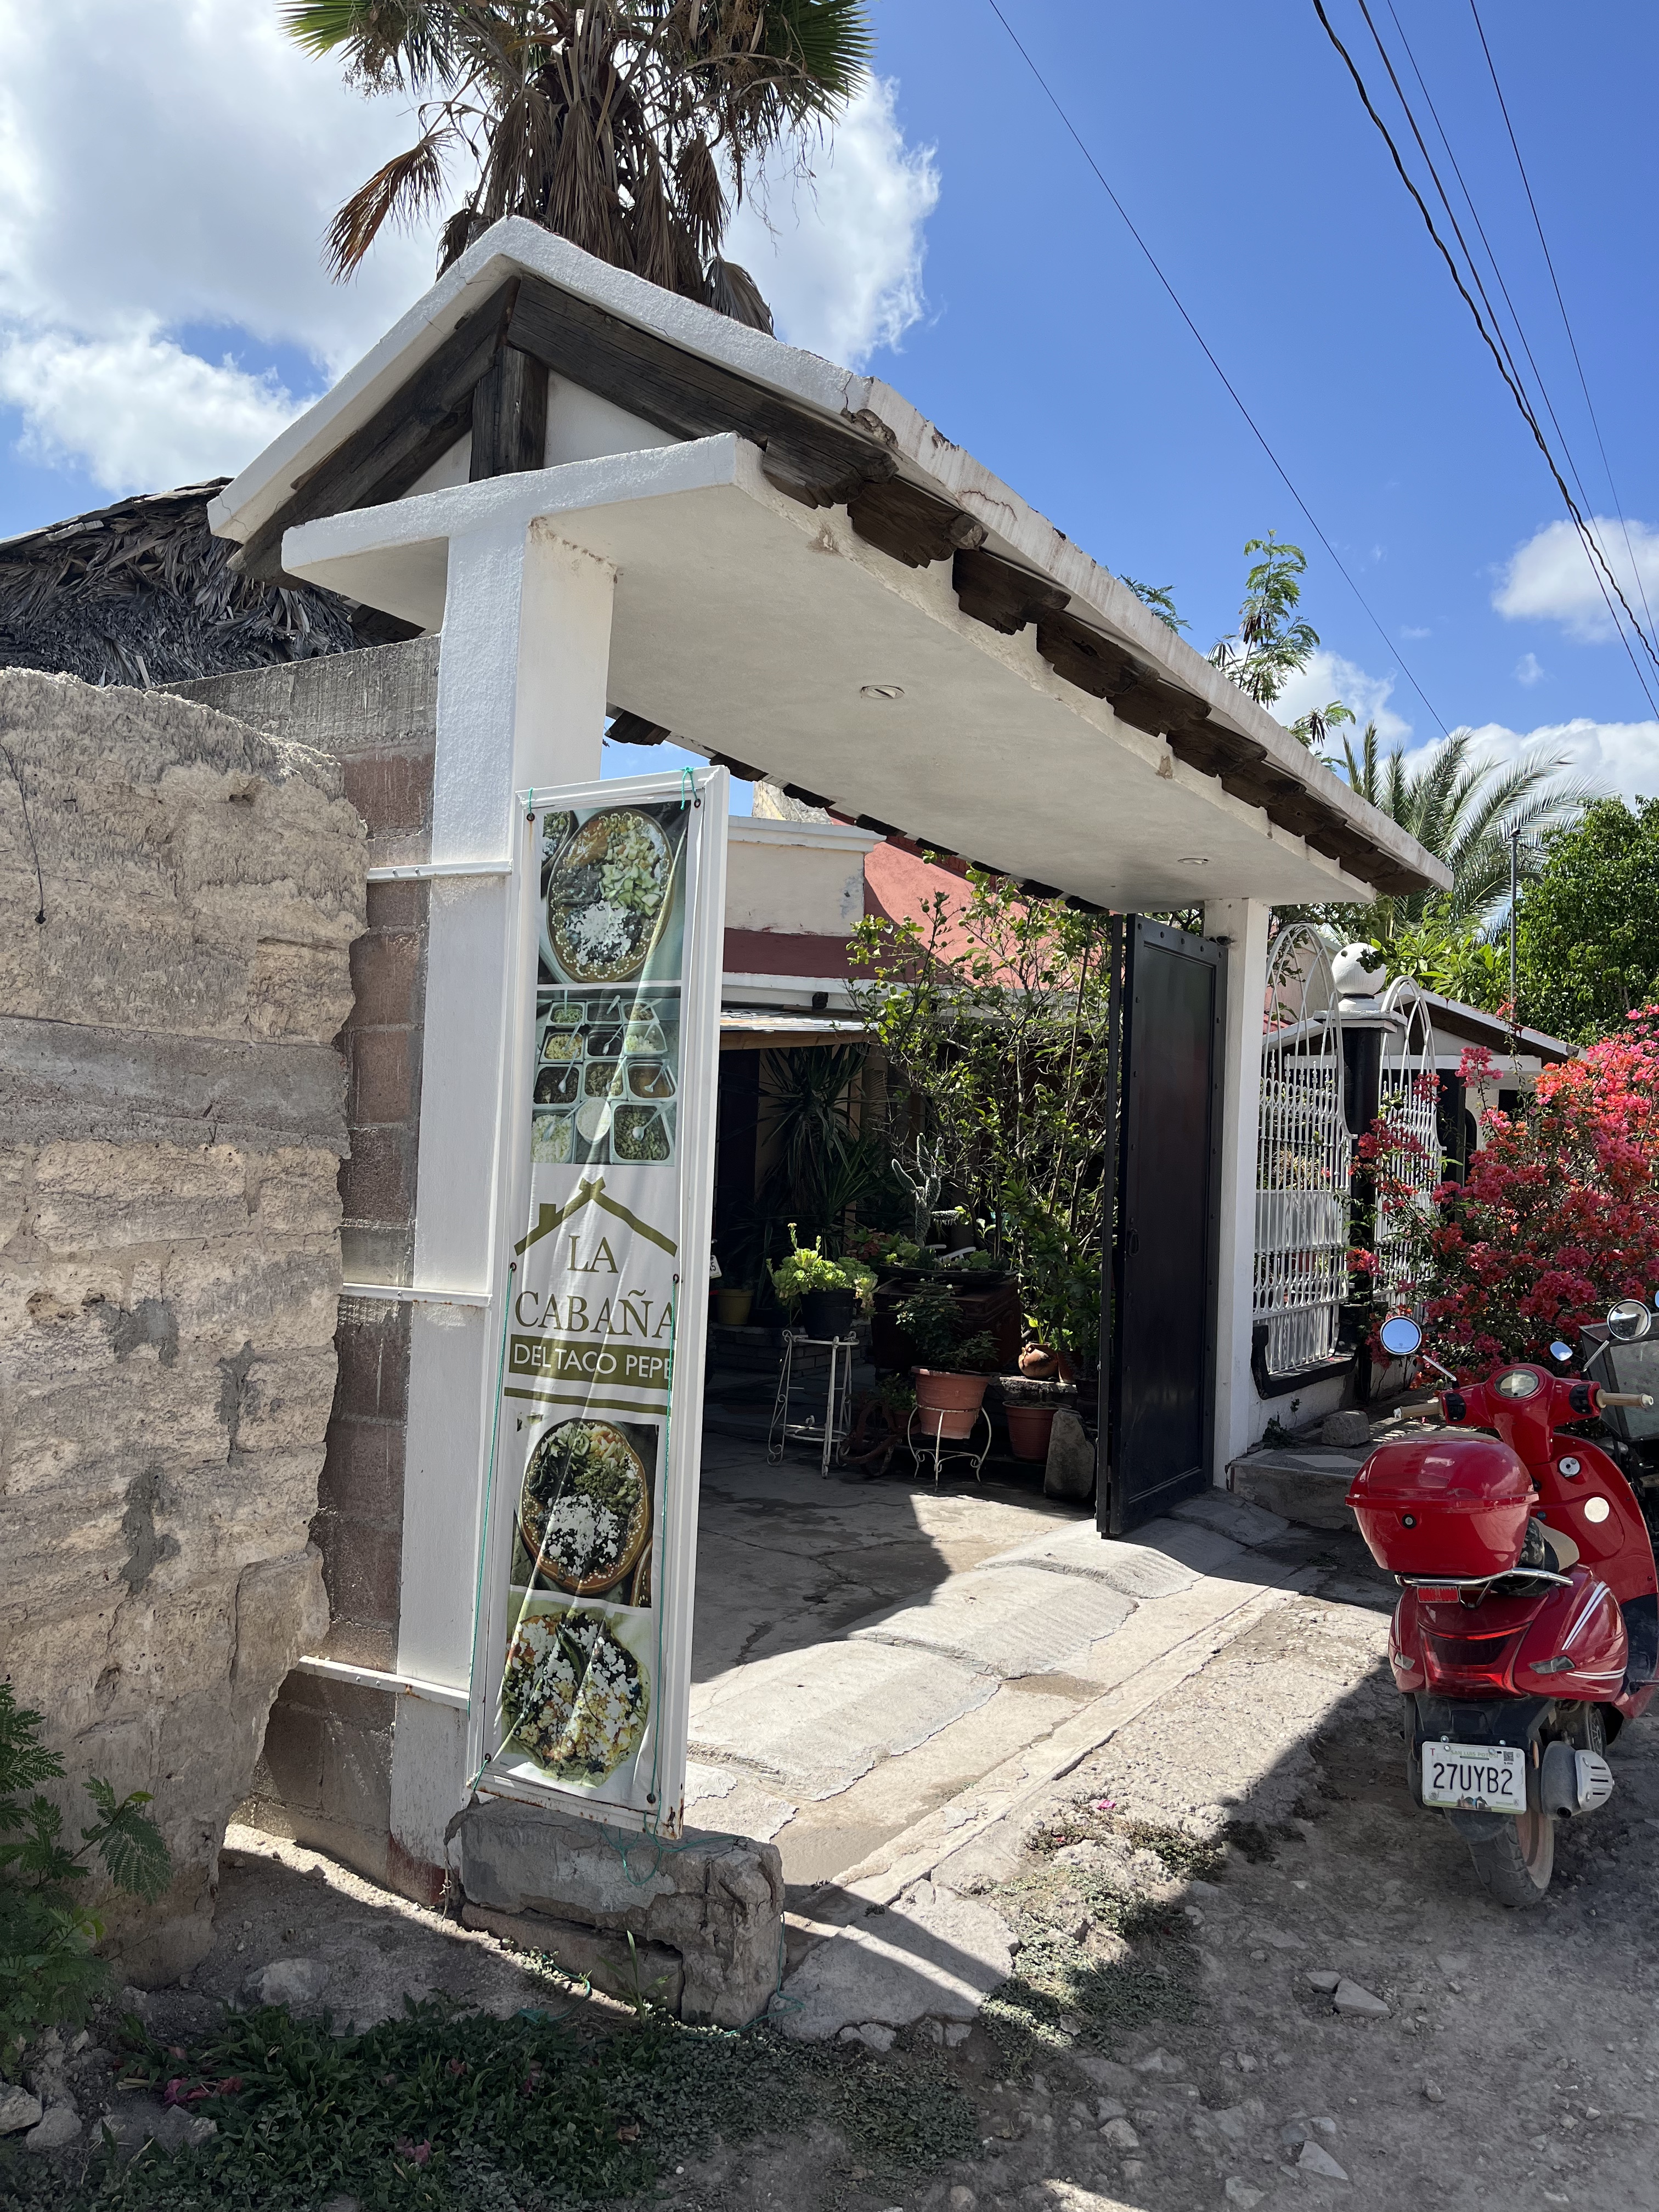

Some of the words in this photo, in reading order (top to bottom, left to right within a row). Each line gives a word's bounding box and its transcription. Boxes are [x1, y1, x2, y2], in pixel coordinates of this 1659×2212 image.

[567, 1235, 619, 1273] LA
[515, 1289, 676, 1340] CABAÑA
[625, 1354, 673, 1379] PEPE
[1433, 1762, 1513, 1795] 27UYB2
